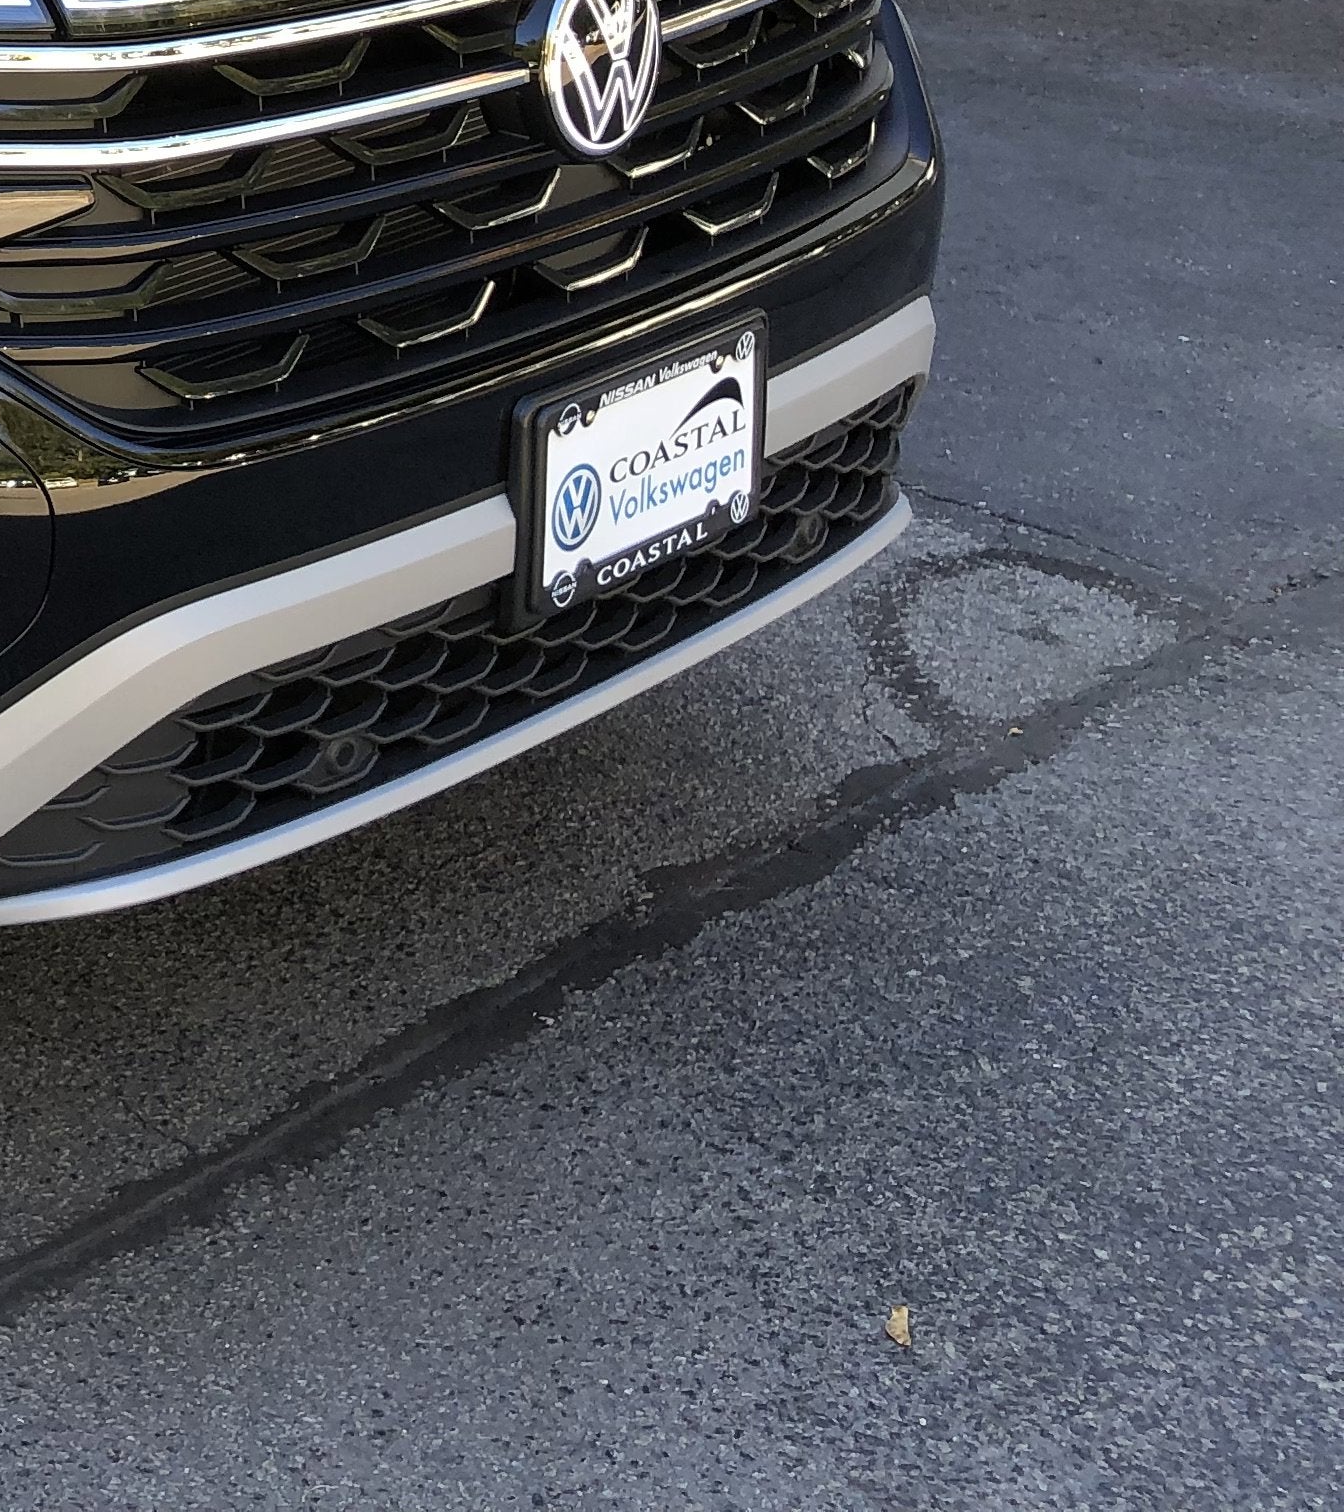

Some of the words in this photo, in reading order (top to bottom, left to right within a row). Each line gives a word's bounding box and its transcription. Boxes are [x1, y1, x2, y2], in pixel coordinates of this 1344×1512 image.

[599, 373, 657, 409] NISSAN
[658, 350, 718, 383] Volkswagen
[609, 409, 746, 483] COASTAL
[609, 448, 746, 526] Volkswagen
[596, 521, 708, 586] COASTAL
